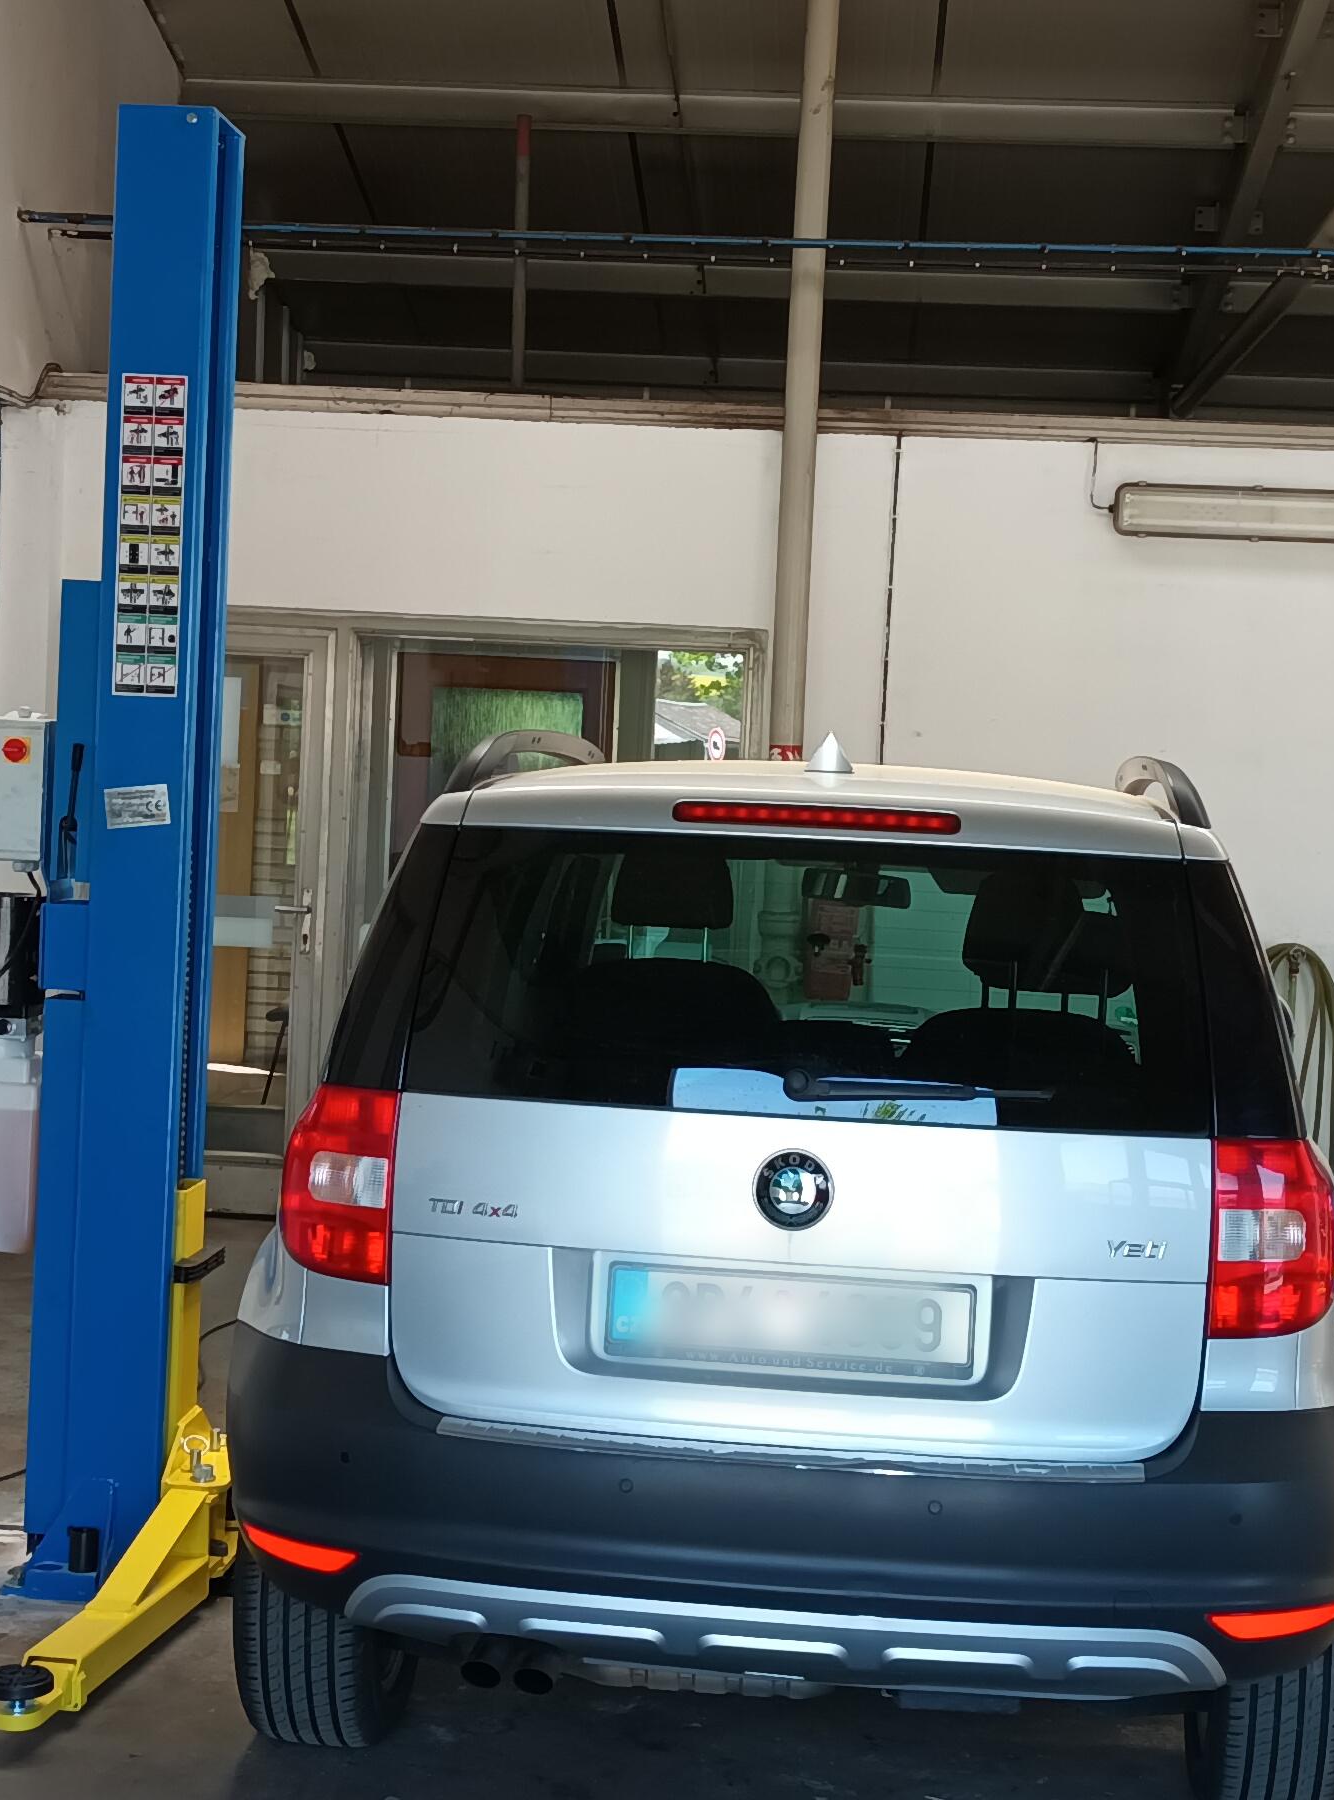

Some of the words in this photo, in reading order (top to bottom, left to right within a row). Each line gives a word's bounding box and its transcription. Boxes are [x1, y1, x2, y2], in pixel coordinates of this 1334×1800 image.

[428, 1197, 464, 1215] TDI
[472, 1202, 518, 1218] 4x4
[1107, 1239, 1168, 1260] Yeti
